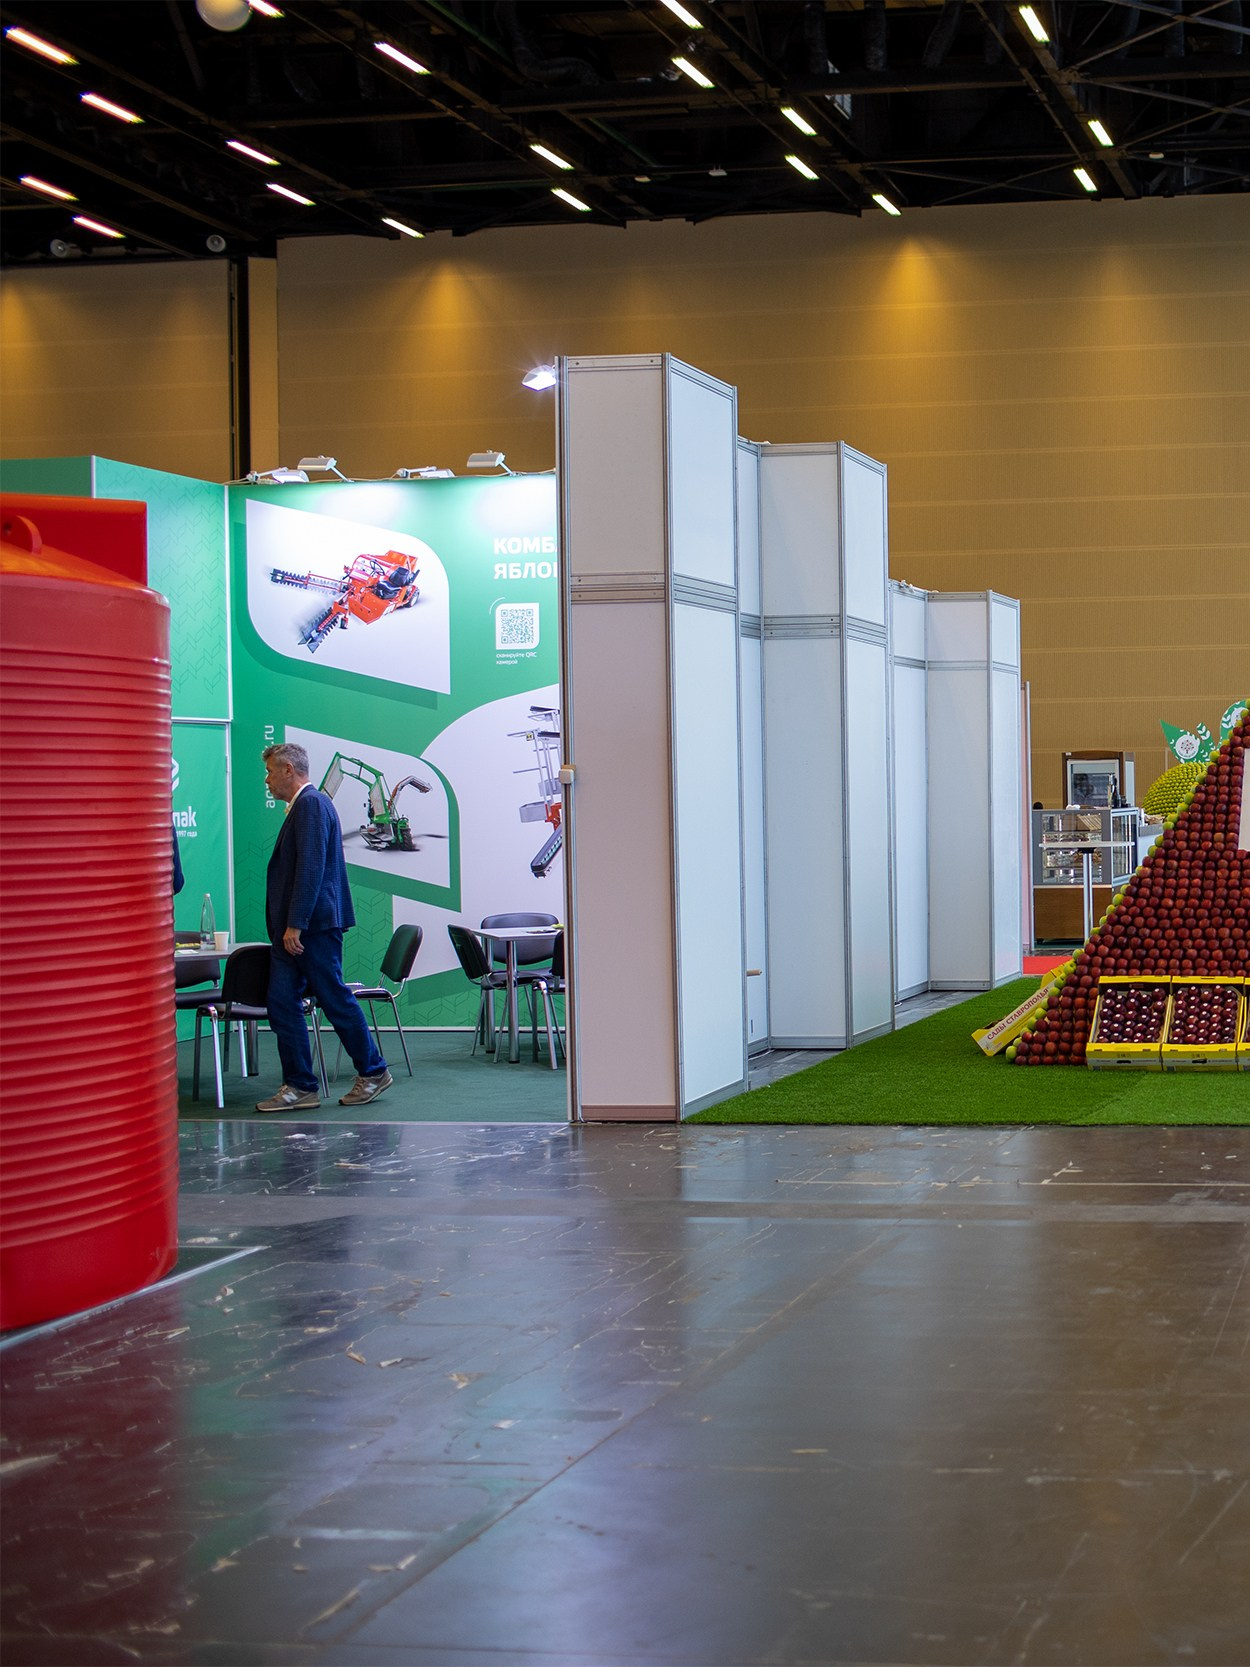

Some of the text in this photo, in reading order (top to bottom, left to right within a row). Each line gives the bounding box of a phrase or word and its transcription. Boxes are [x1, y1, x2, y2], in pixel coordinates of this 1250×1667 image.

[494, 536, 557, 555] КОМБ
[987, 987, 1049, 1041] САДЫ СТАВРОПОЛЬЯ
